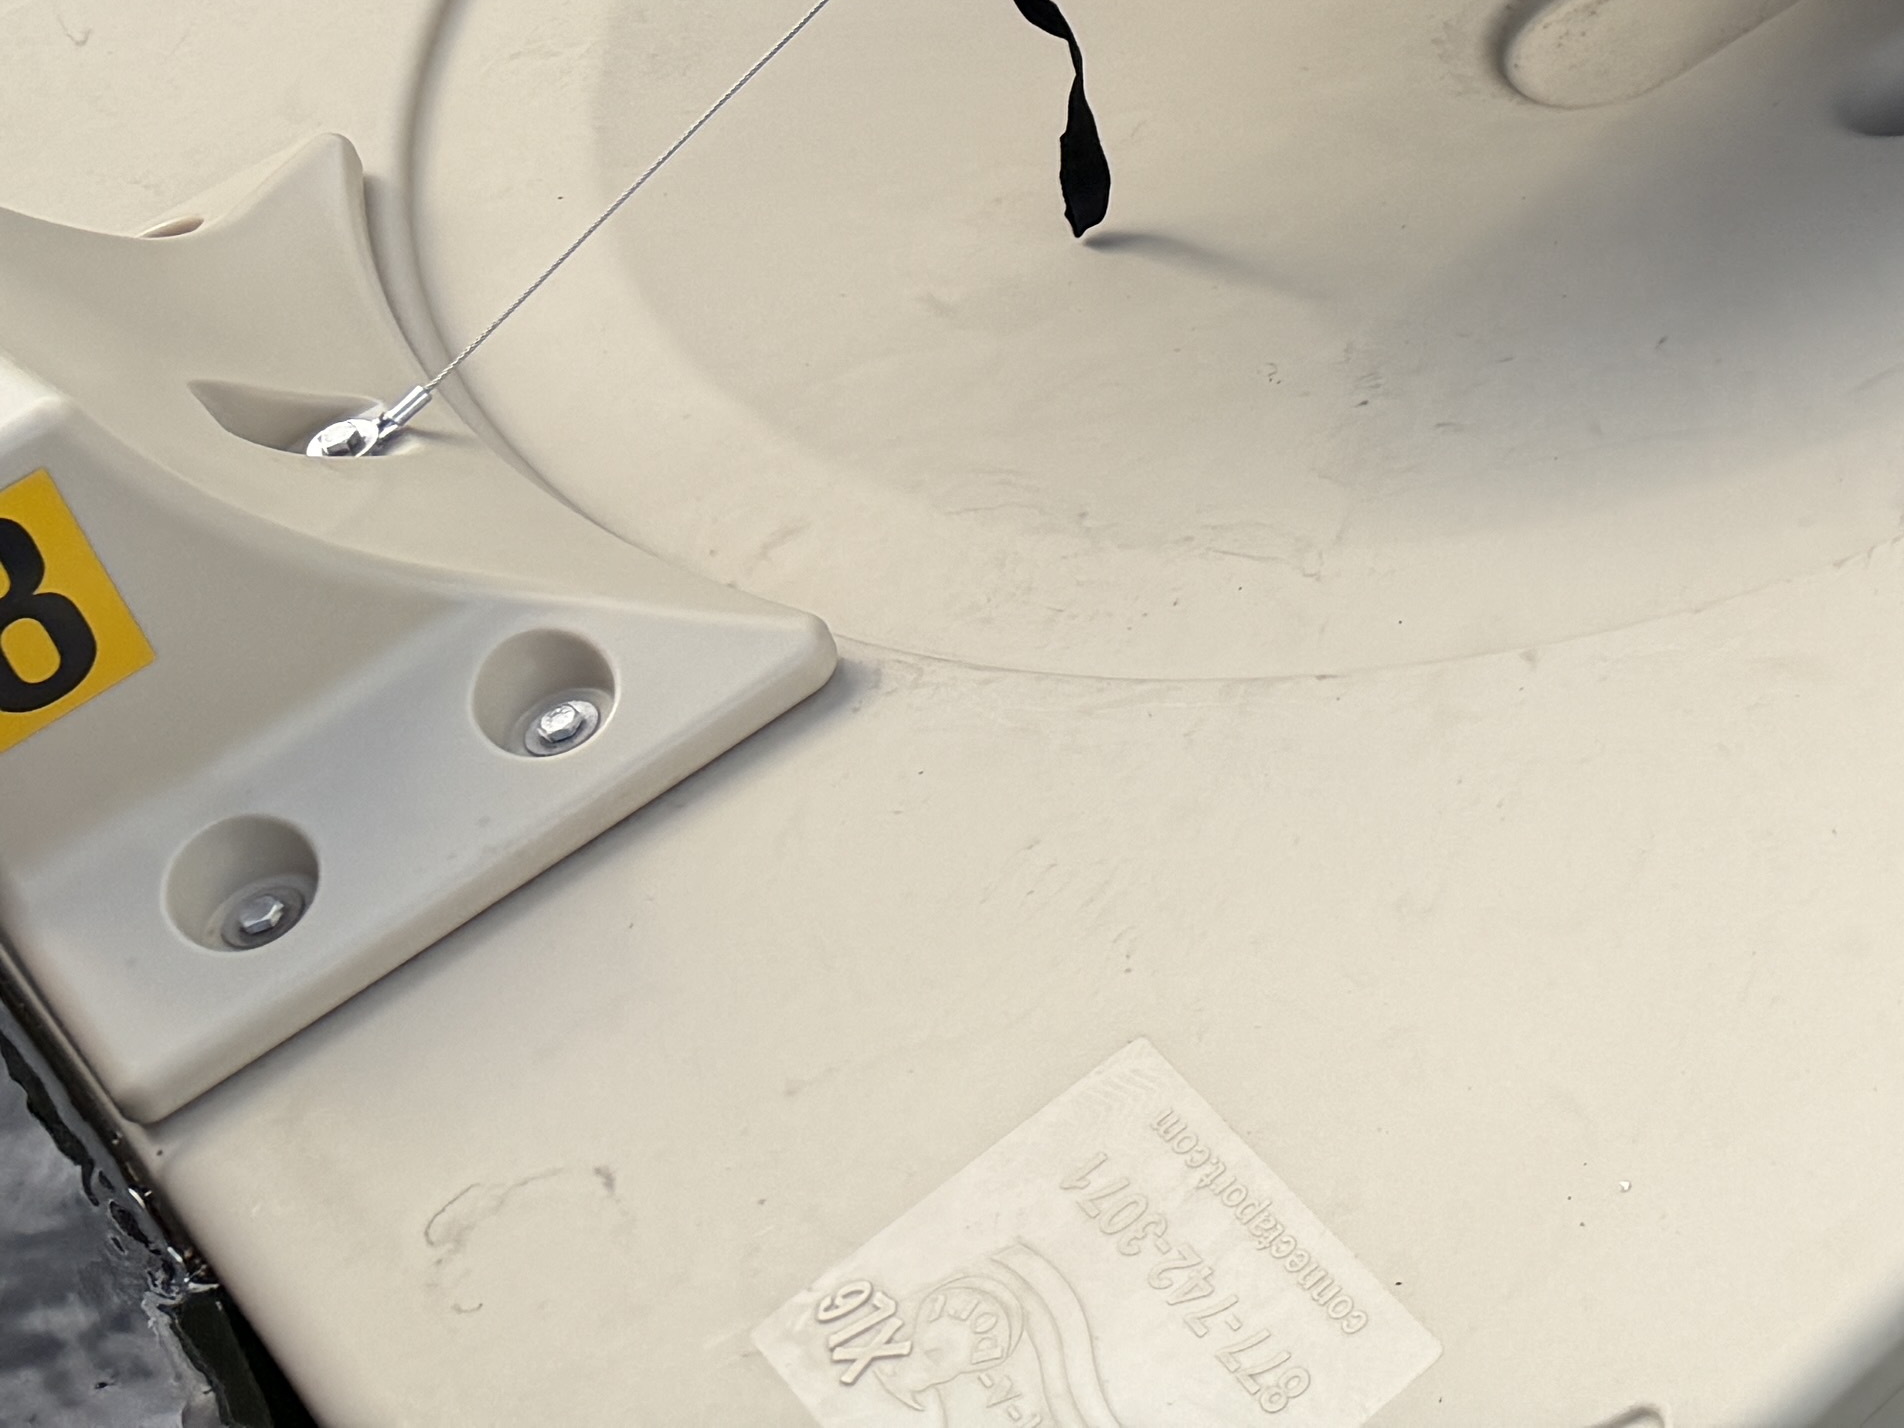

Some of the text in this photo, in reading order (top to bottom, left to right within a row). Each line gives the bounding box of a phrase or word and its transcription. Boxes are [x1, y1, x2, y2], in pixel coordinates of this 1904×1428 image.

[0, 517, 97, 713] 8
[1058, 1151, 1312, 1416] 877-742-3071
[1149, 1107, 1370, 1336] connectaport.com
